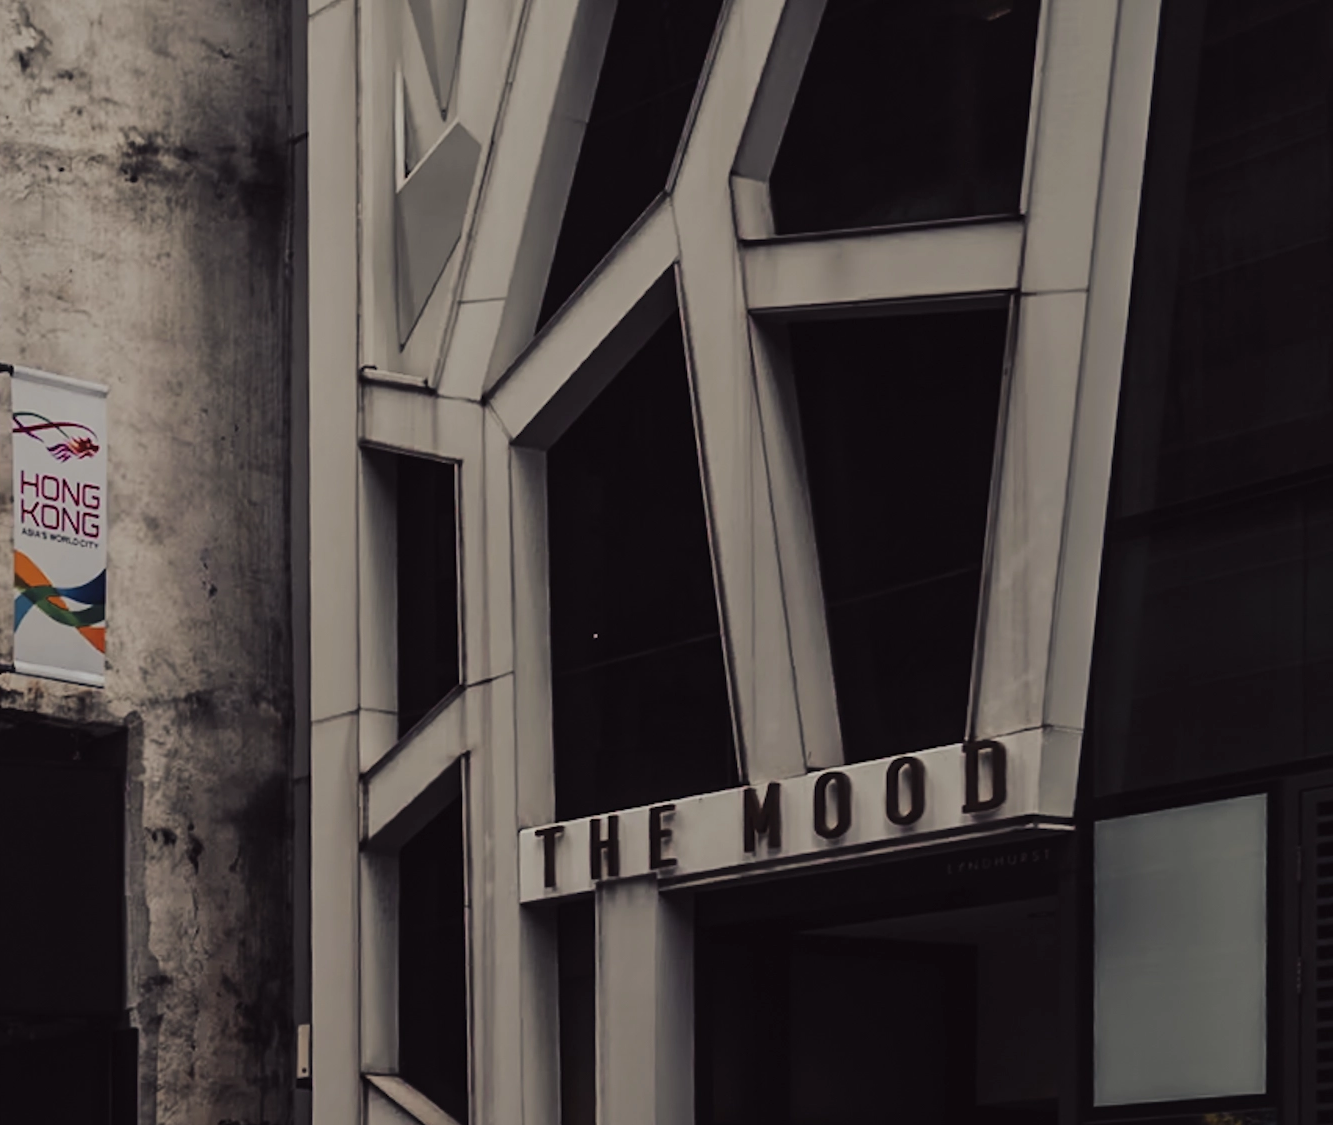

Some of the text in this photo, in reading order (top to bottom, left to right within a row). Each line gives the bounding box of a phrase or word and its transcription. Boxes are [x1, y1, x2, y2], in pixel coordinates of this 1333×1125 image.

[21, 470, 100, 509] HONG
[21, 499, 100, 538] KONG
[22, 528, 99, 549] ASIA'S WORLD CITY
[535, 738, 1008, 889] THE MOOD
[947, 848, 1051, 875] LYNDHURST
